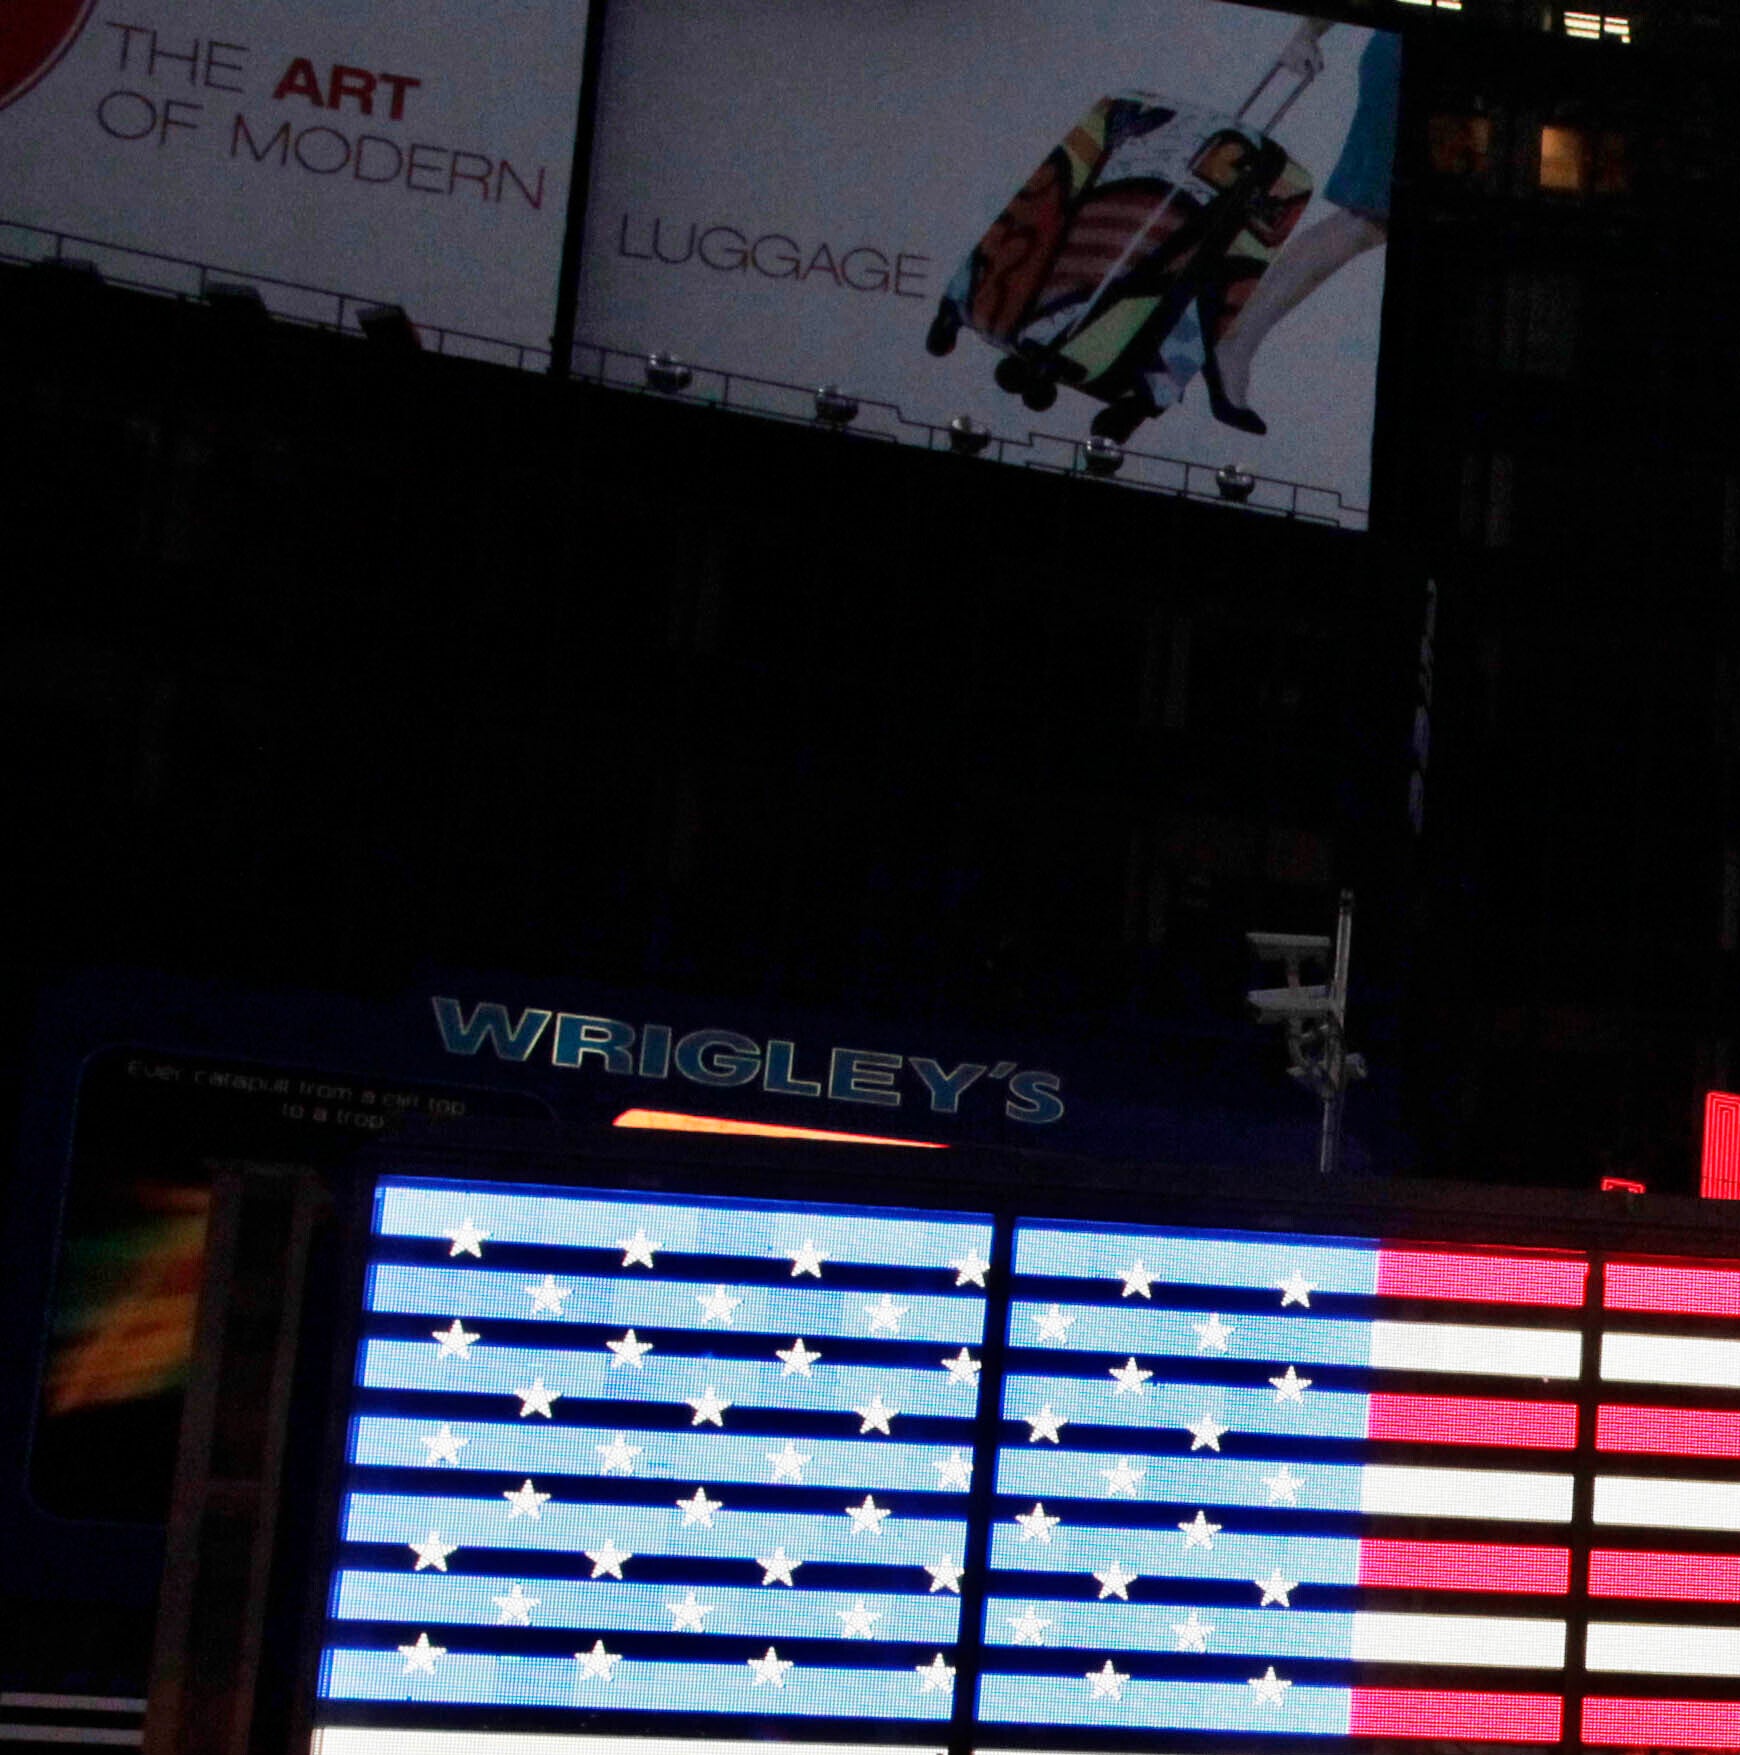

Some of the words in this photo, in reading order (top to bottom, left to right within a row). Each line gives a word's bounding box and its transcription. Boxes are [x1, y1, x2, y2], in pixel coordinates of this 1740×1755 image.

[107, 21, 250, 93] THE
[273, 57, 421, 121] ART
[97, 88, 204, 147] OF
[230, 112, 546, 210] MODERN
[618, 213, 931, 300] LUGGAGE
[430, 996, 1067, 1126] WRIGLEY'S
